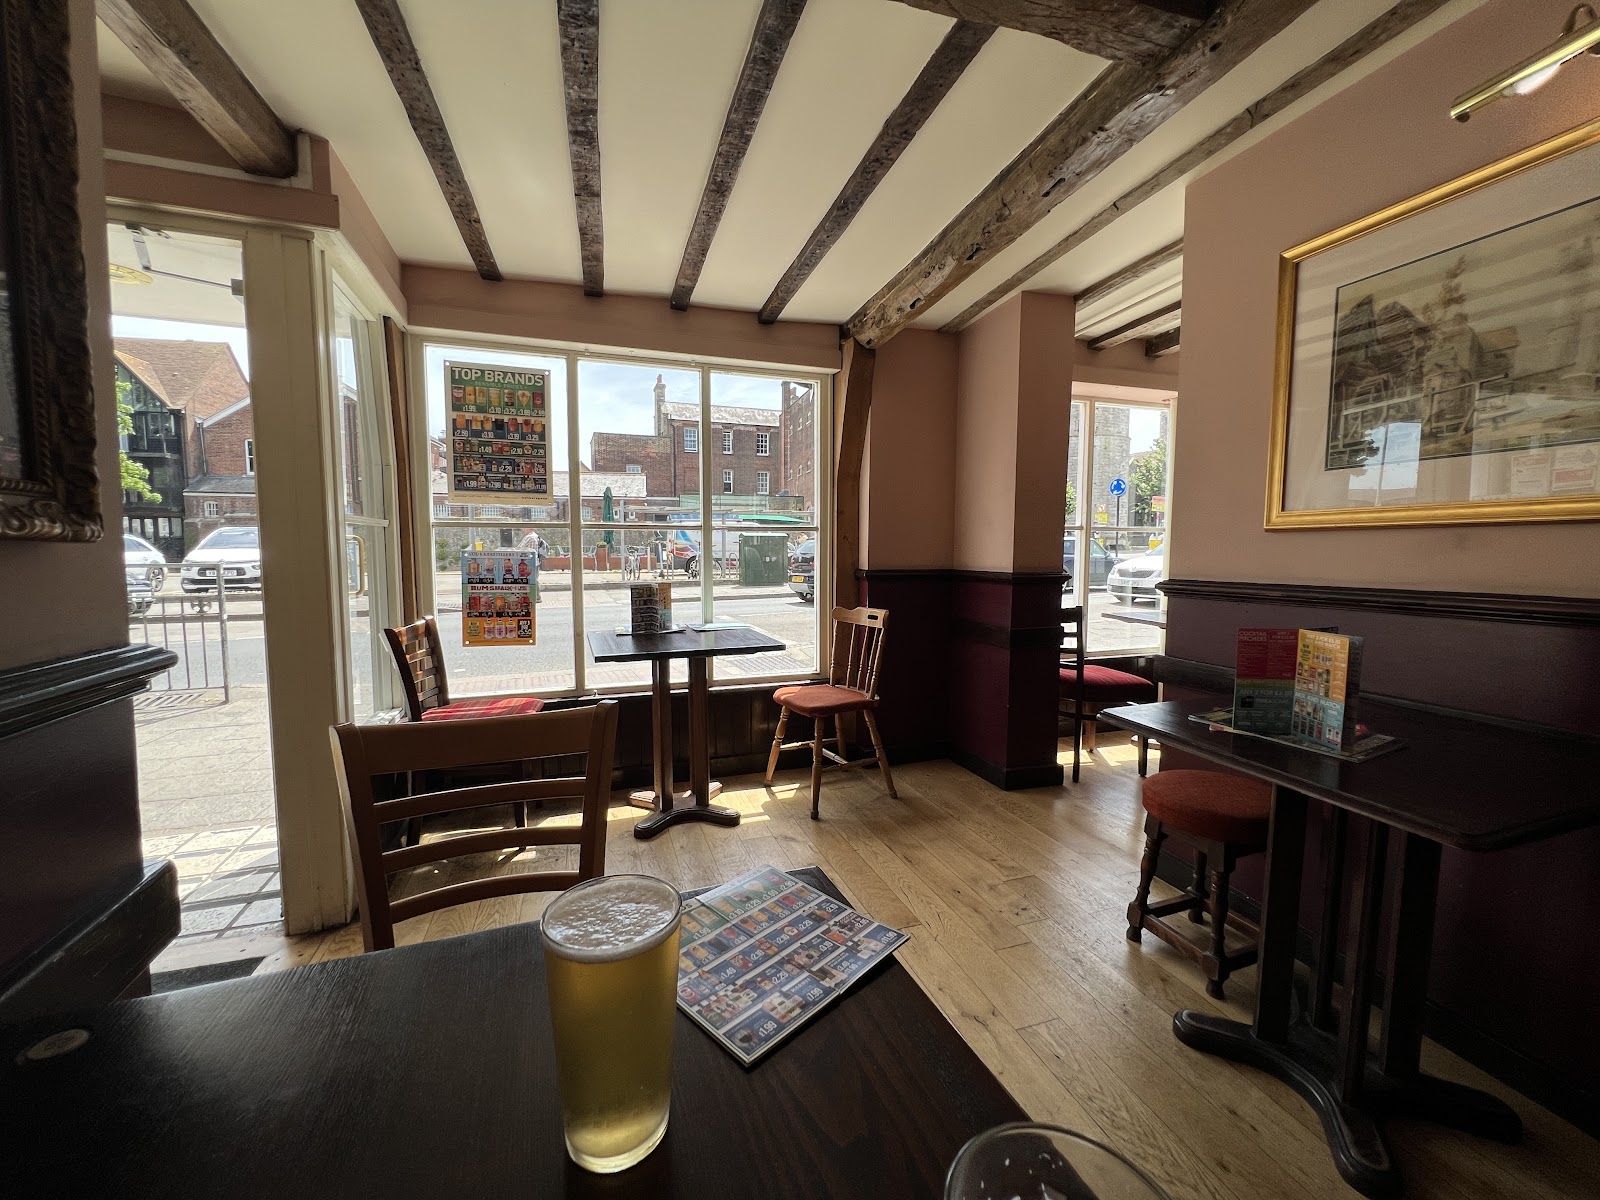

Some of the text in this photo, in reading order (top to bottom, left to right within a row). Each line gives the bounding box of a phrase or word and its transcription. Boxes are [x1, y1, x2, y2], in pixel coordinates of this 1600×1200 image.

[452, 367, 543, 386] TOP BRANDS
[693, 927, 712, 940] £1.99
[720, 967, 737, 980] £1.49
[771, 971, 789, 984] £2.29
[806, 987, 824, 1002] £7.99
[758, 1020, 778, 1037] £1.99
